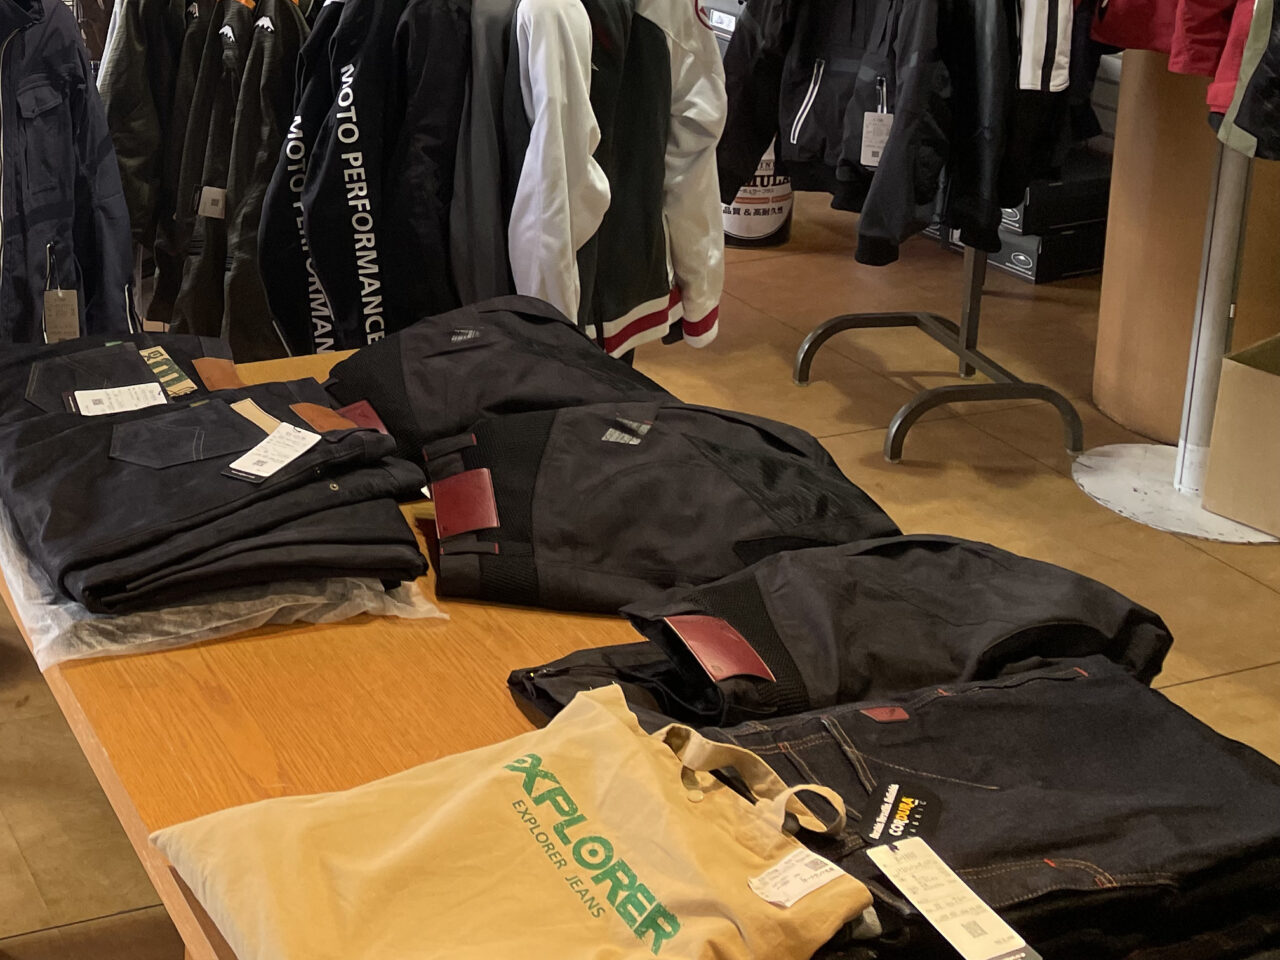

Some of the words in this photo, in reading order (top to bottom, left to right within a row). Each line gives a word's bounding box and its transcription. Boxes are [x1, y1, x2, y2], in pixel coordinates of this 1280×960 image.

[336, 63, 359, 144] MOTO
[286, 115, 306, 193] MOTO
[340, 151, 385, 345] PERFORMANCE
[888, 795, 915, 836] CORDURA
[512, 798, 568, 870] EXPLORER
[565, 874, 607, 919] JEANS
